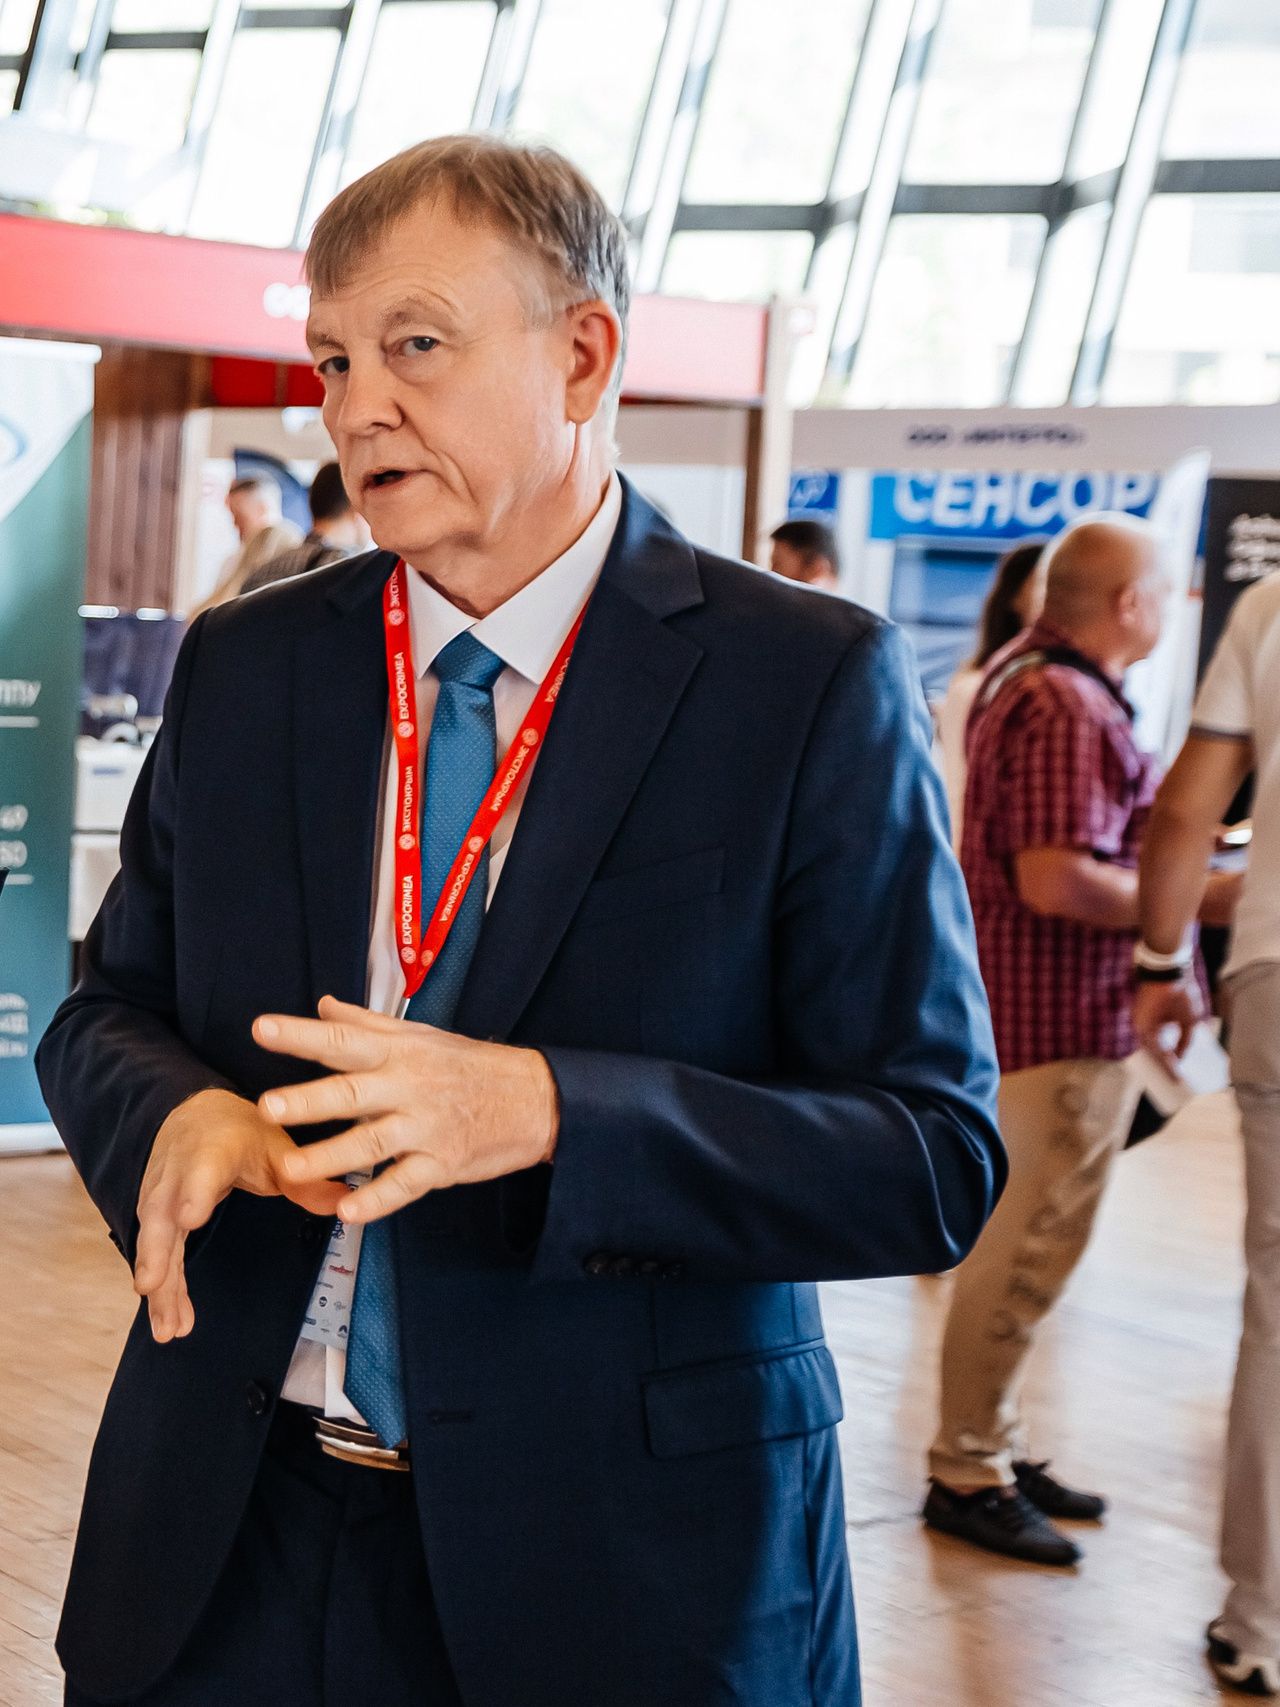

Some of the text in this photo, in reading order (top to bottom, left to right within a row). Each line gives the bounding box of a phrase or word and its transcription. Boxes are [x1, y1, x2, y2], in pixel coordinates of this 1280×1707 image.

[894, 468, 1153, 528] СЕНСОР
[398, 651, 410, 719] EXPOCRIMEA
[403, 765, 413, 833] ЭКСПОКРЫМ
[492, 744, 529, 813] ЭКСПОКРЫМ
[402, 875, 415, 945] EXPOCRIMEA
[439, 853, 475, 923] EXPOCRIMEA
